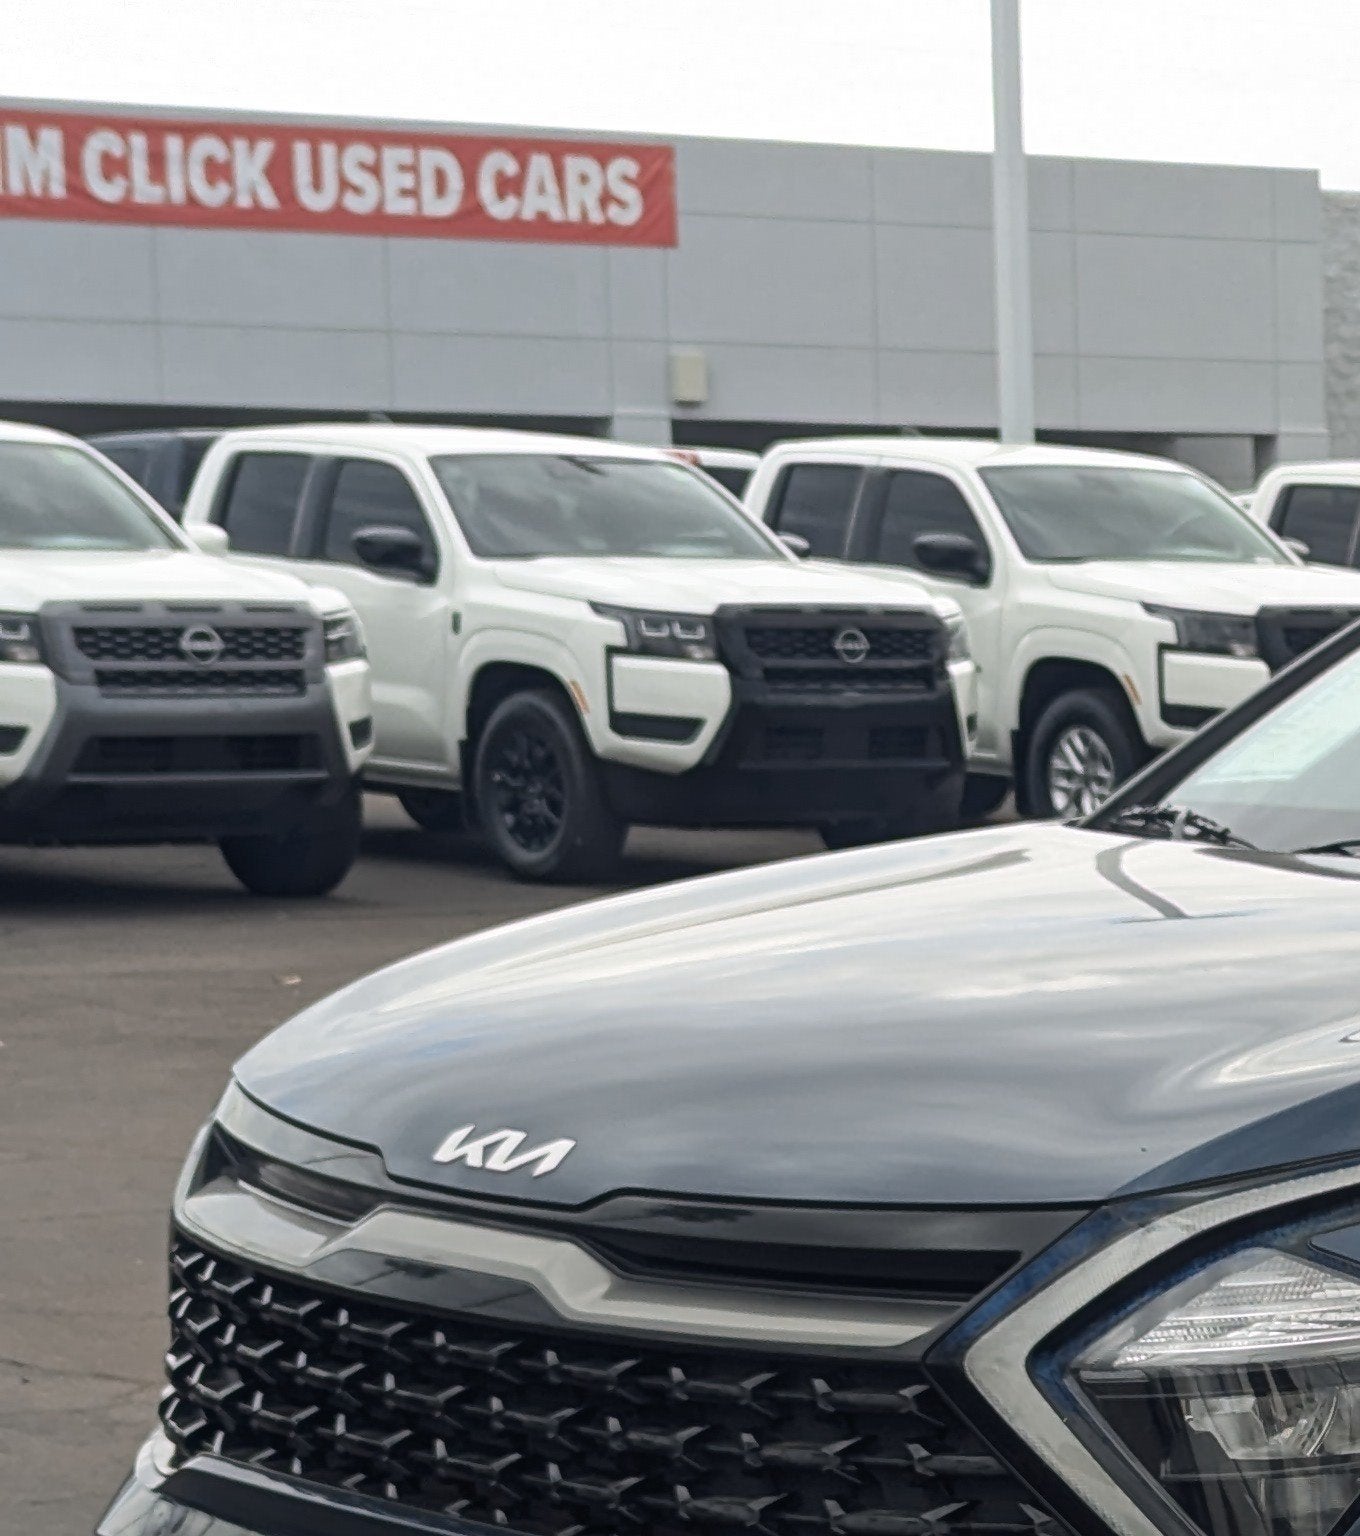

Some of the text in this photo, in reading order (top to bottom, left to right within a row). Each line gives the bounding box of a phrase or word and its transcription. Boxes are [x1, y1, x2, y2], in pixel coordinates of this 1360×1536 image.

[0, 124, 643, 228] M CLICK USED CARS
[432, 1123, 577, 1178] KIA
